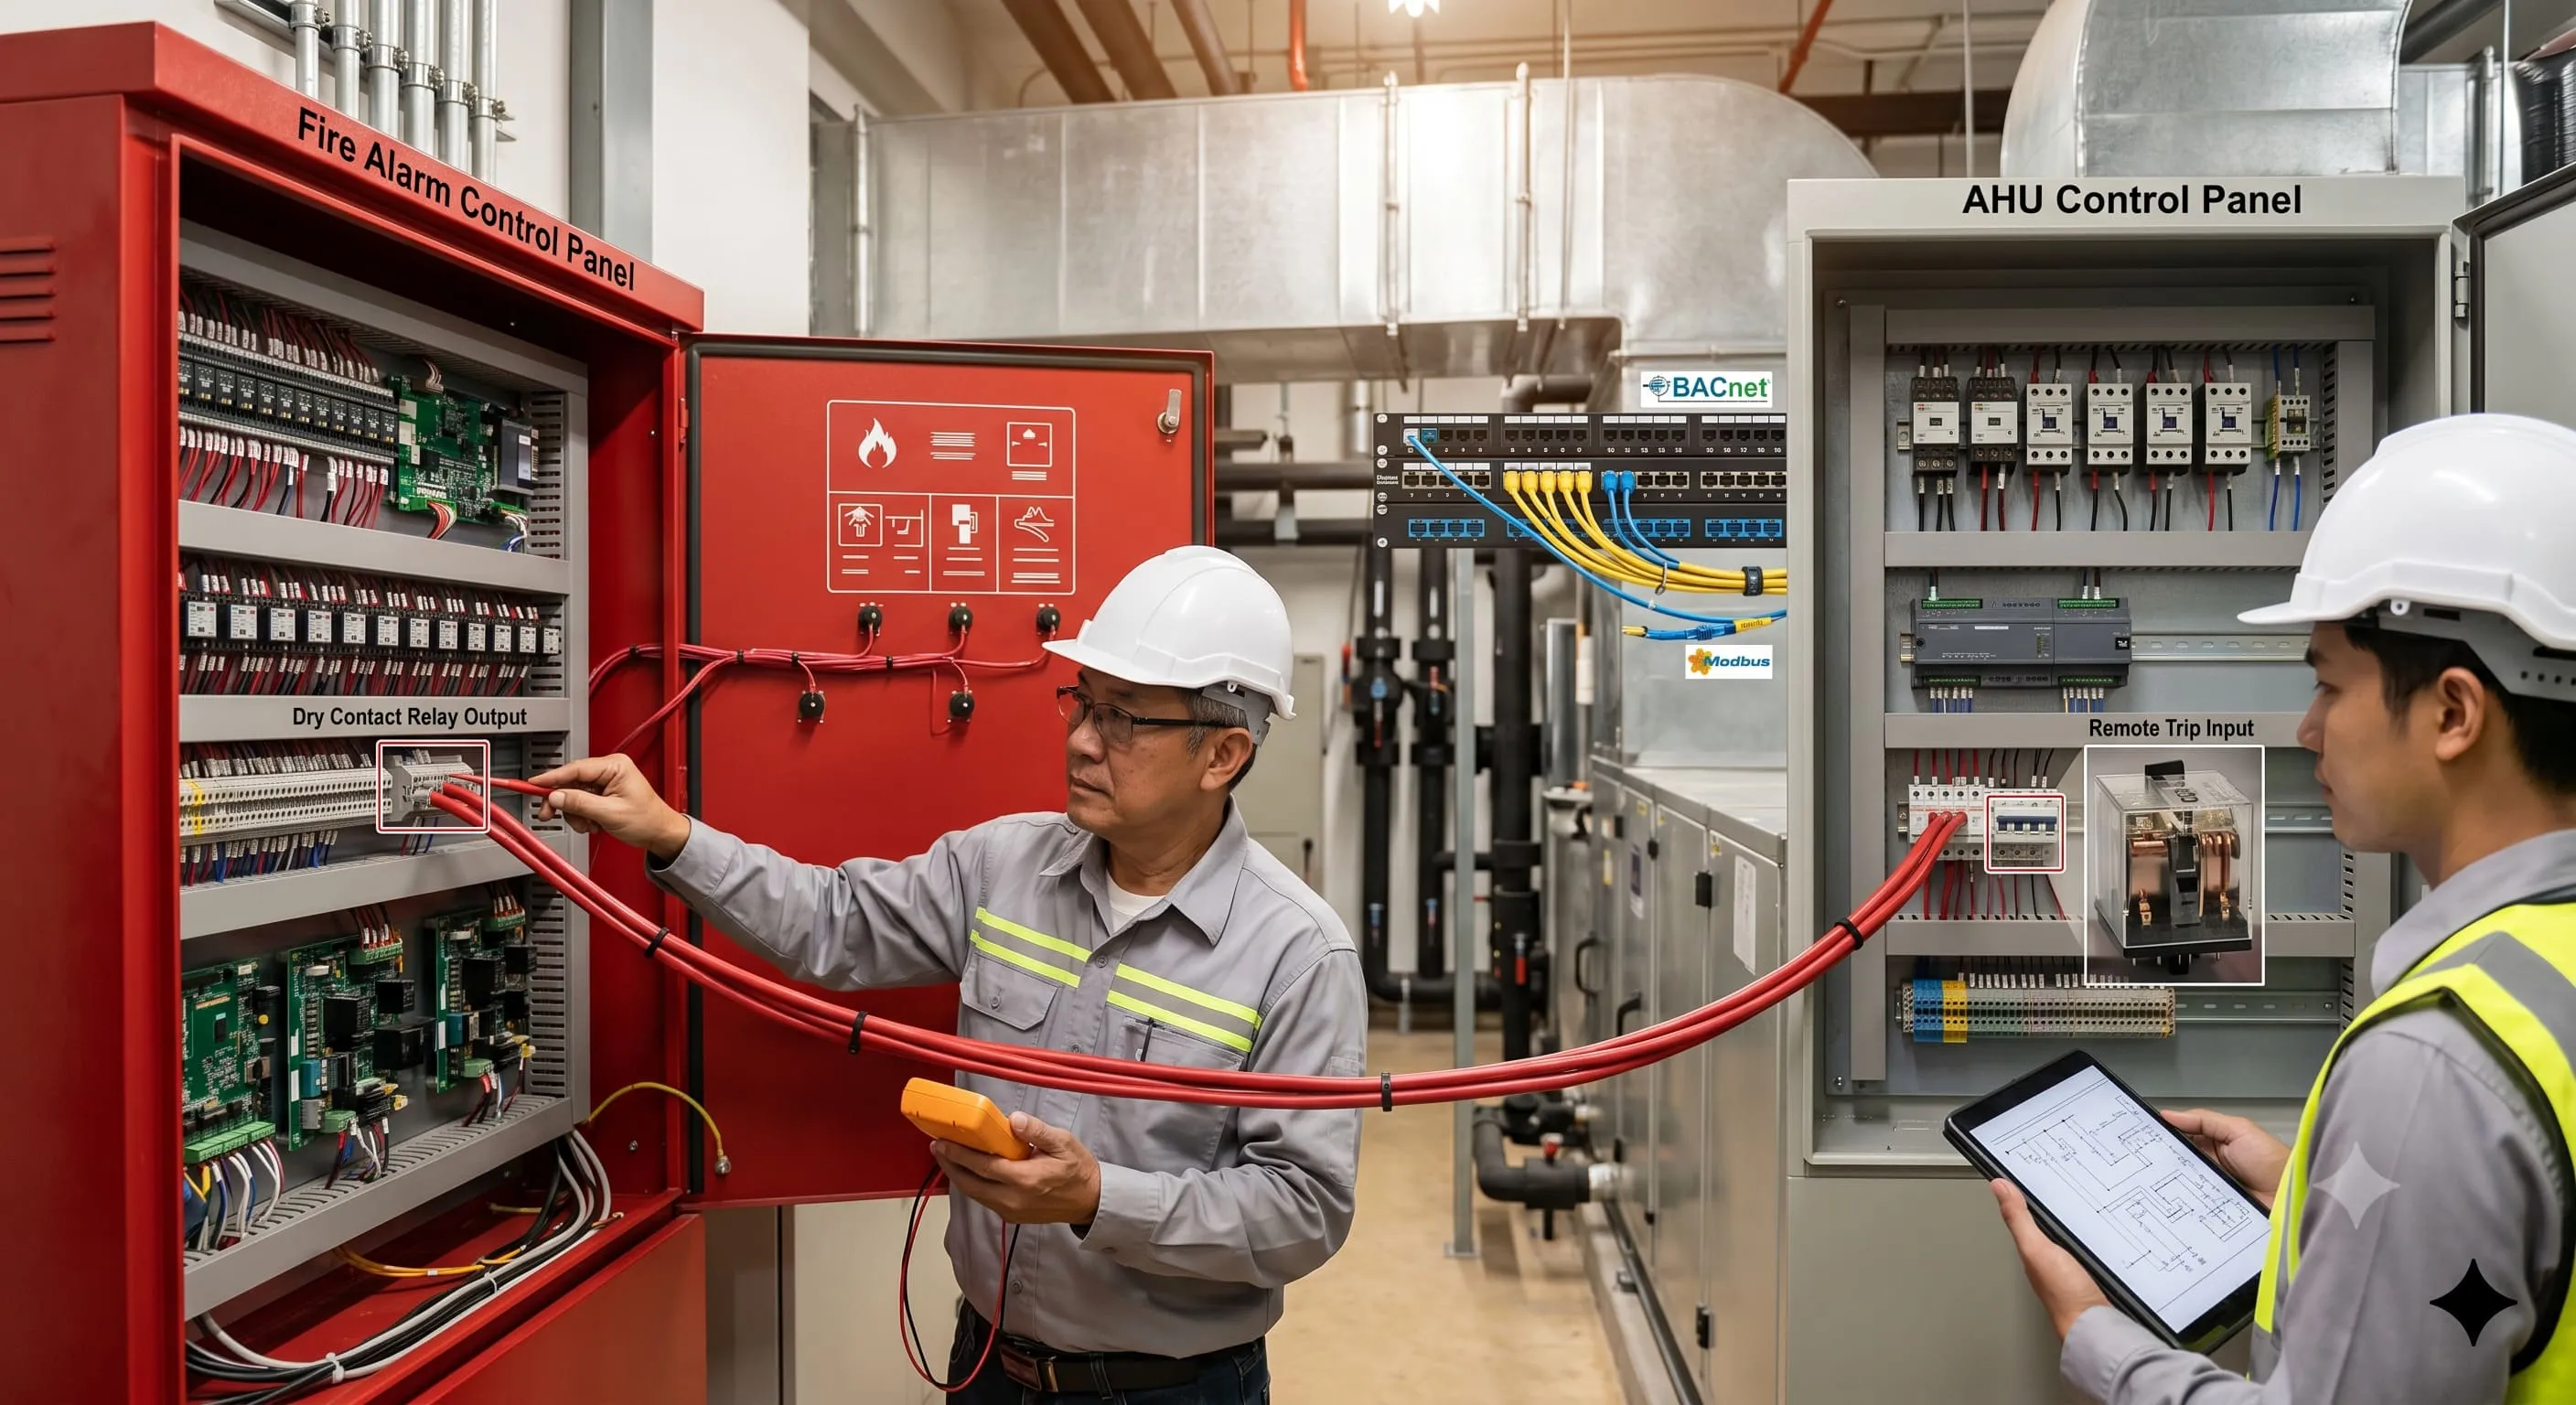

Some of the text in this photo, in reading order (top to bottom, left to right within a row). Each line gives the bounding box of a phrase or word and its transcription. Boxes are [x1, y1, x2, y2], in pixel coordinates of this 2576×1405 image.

[298, 106, 634, 291] Fire Alarm Control Panel
[1962, 184, 2302, 214] AHU Control Panel
[293, 707, 528, 730] Dry Contact Relay Output
[2089, 718, 2255, 741] Remote Trip Input
